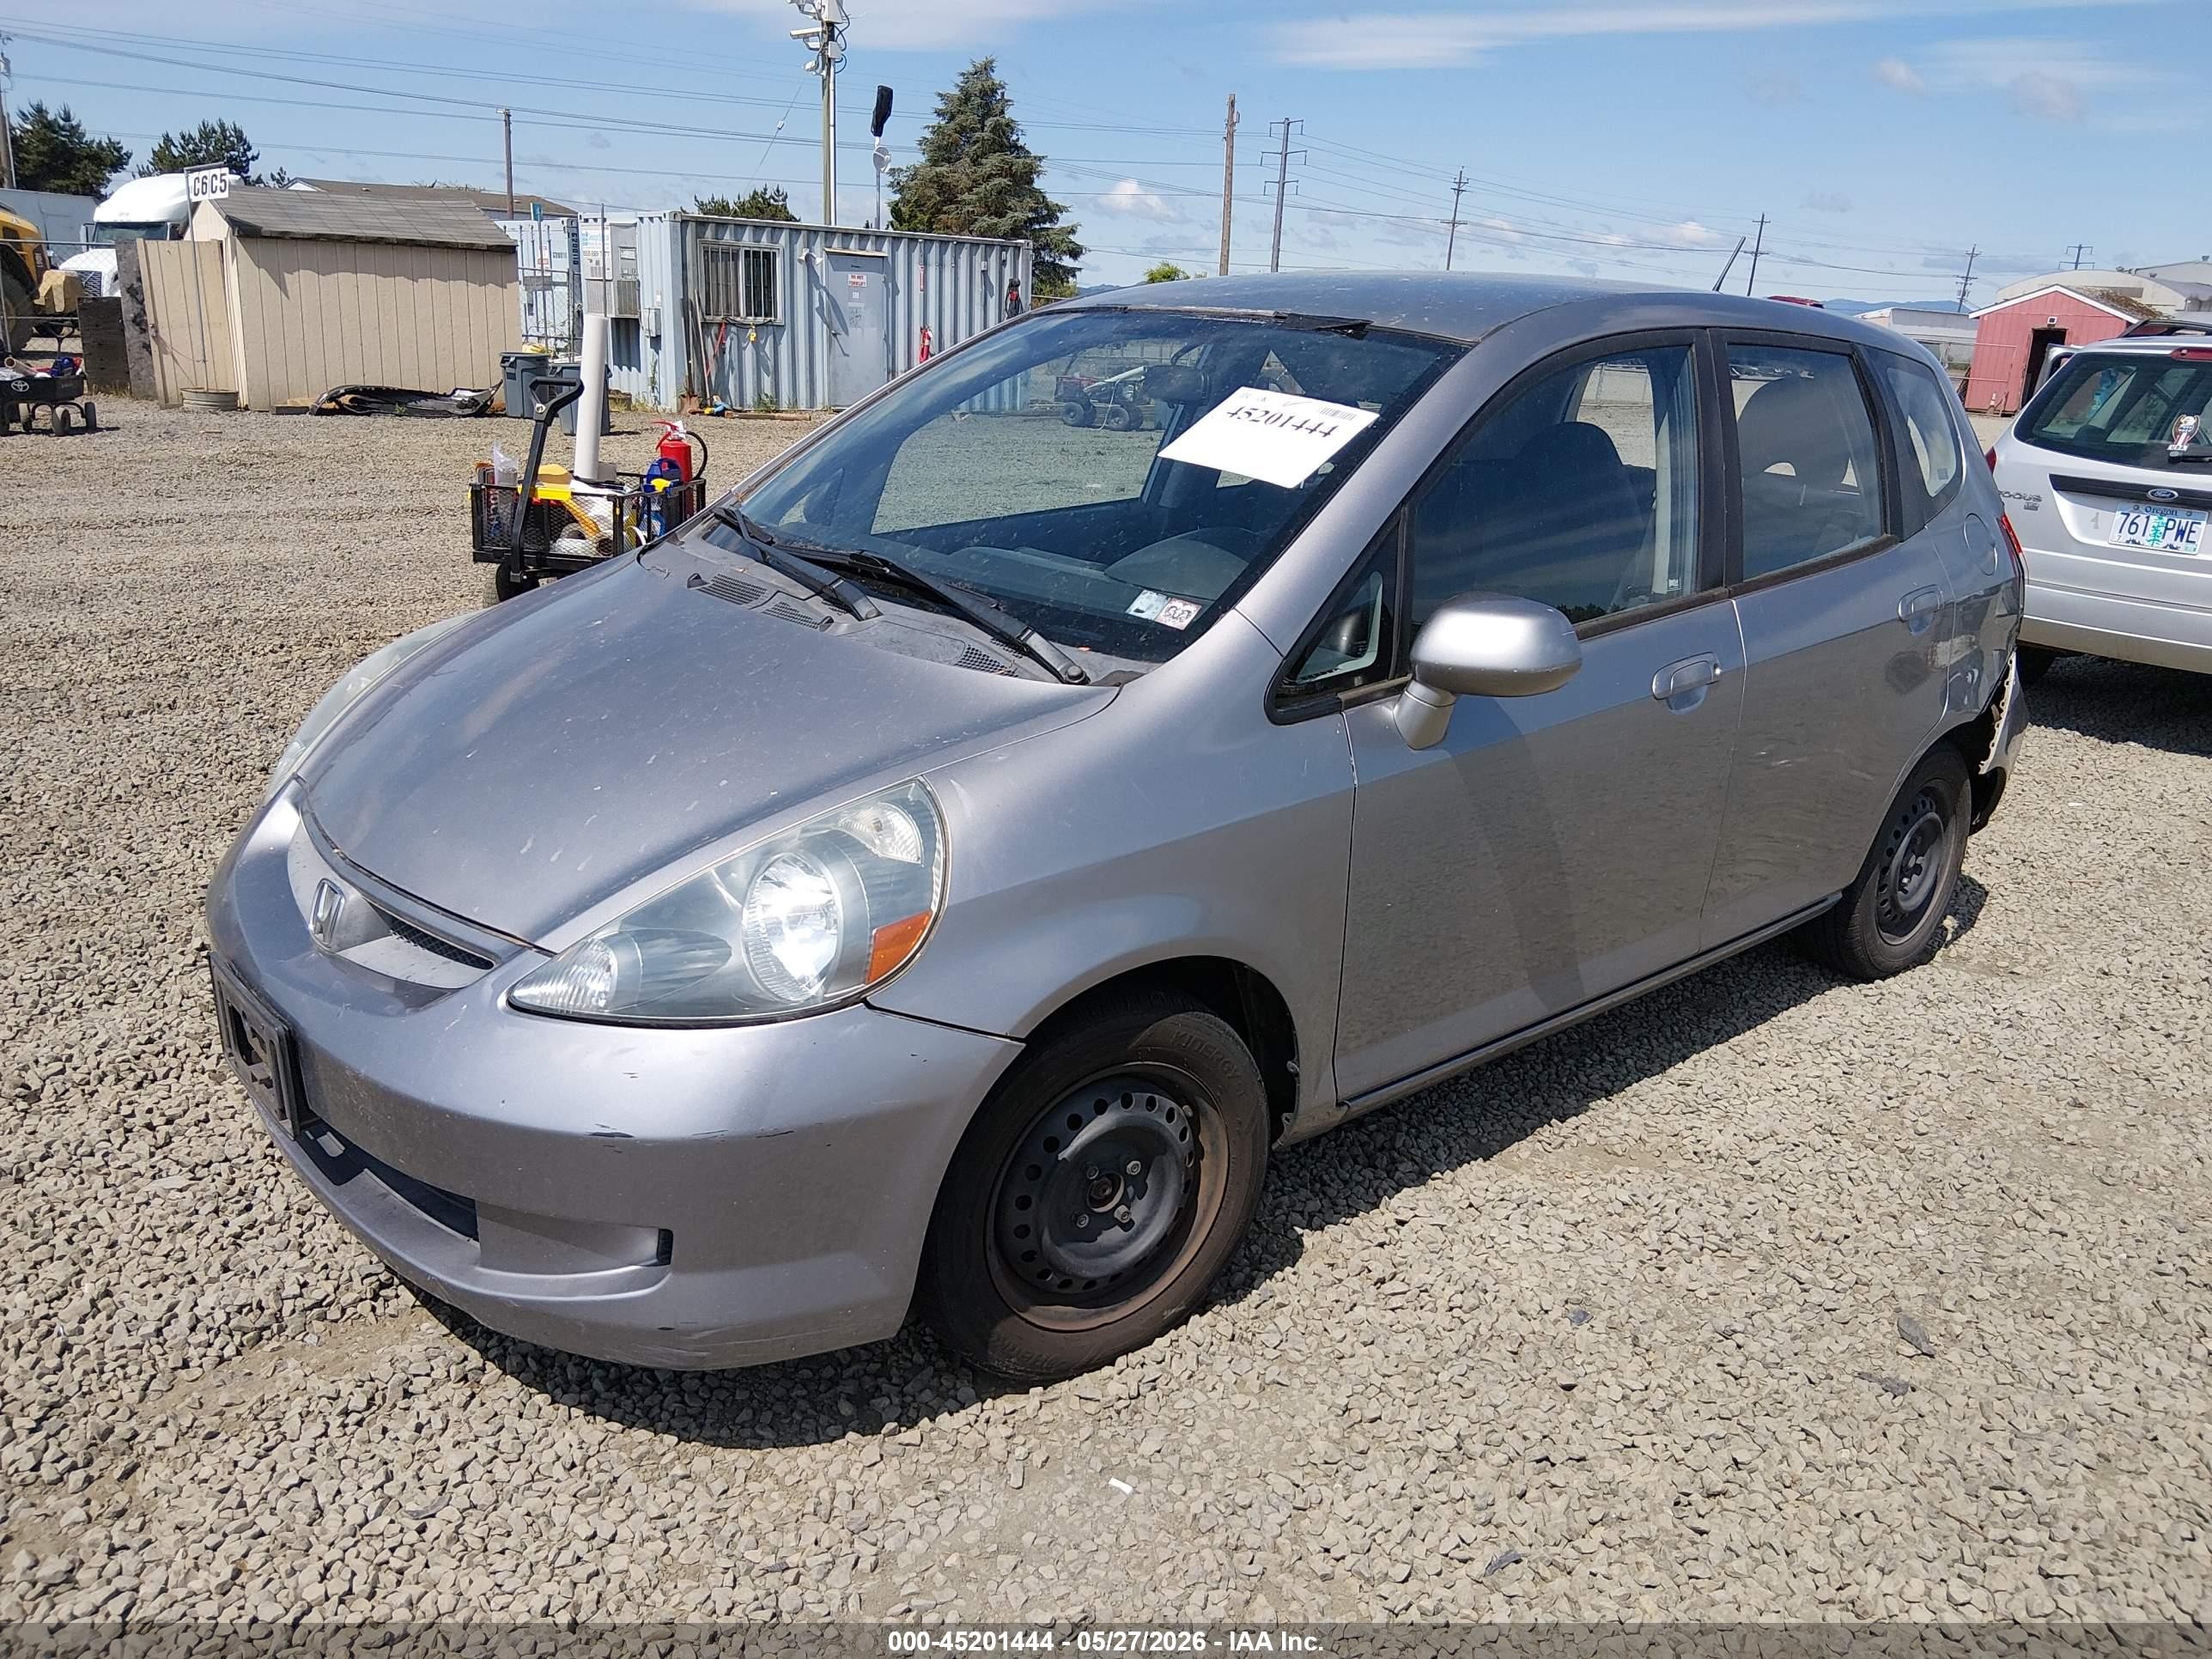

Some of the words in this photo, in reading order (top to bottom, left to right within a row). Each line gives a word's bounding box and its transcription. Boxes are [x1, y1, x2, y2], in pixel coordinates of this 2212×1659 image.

[193, 175, 208, 197] C6
[210, 173, 227, 193] C5
[1226, 405, 1339, 438] 45201444
[2144, 505, 2179, 517] Oregon
[2118, 512, 2151, 538] 761
[2161, 518, 2202, 544] PWE
